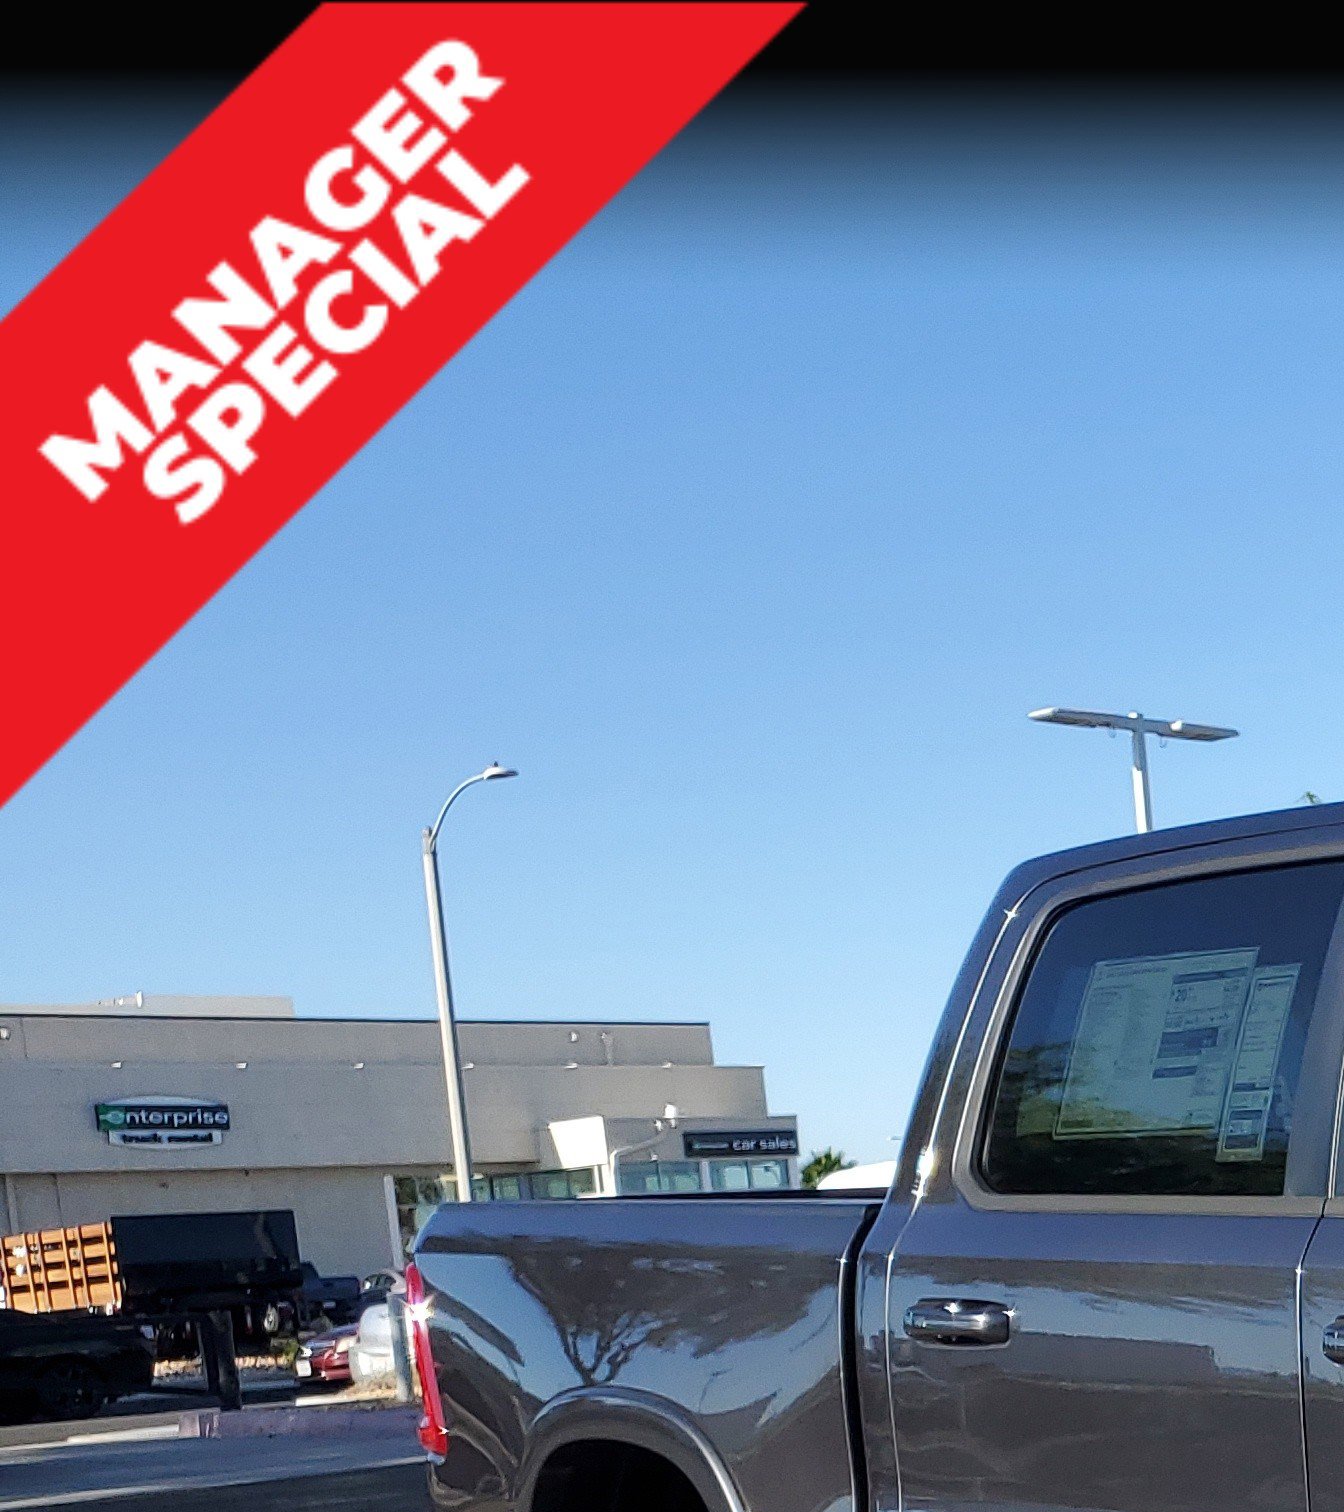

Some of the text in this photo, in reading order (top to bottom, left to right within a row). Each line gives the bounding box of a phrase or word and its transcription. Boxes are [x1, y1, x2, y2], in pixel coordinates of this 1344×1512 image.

[100, 1108, 229, 1128] enterprise
[732, 1139, 756, 1151] car
[759, 1135, 797, 1150] sales
